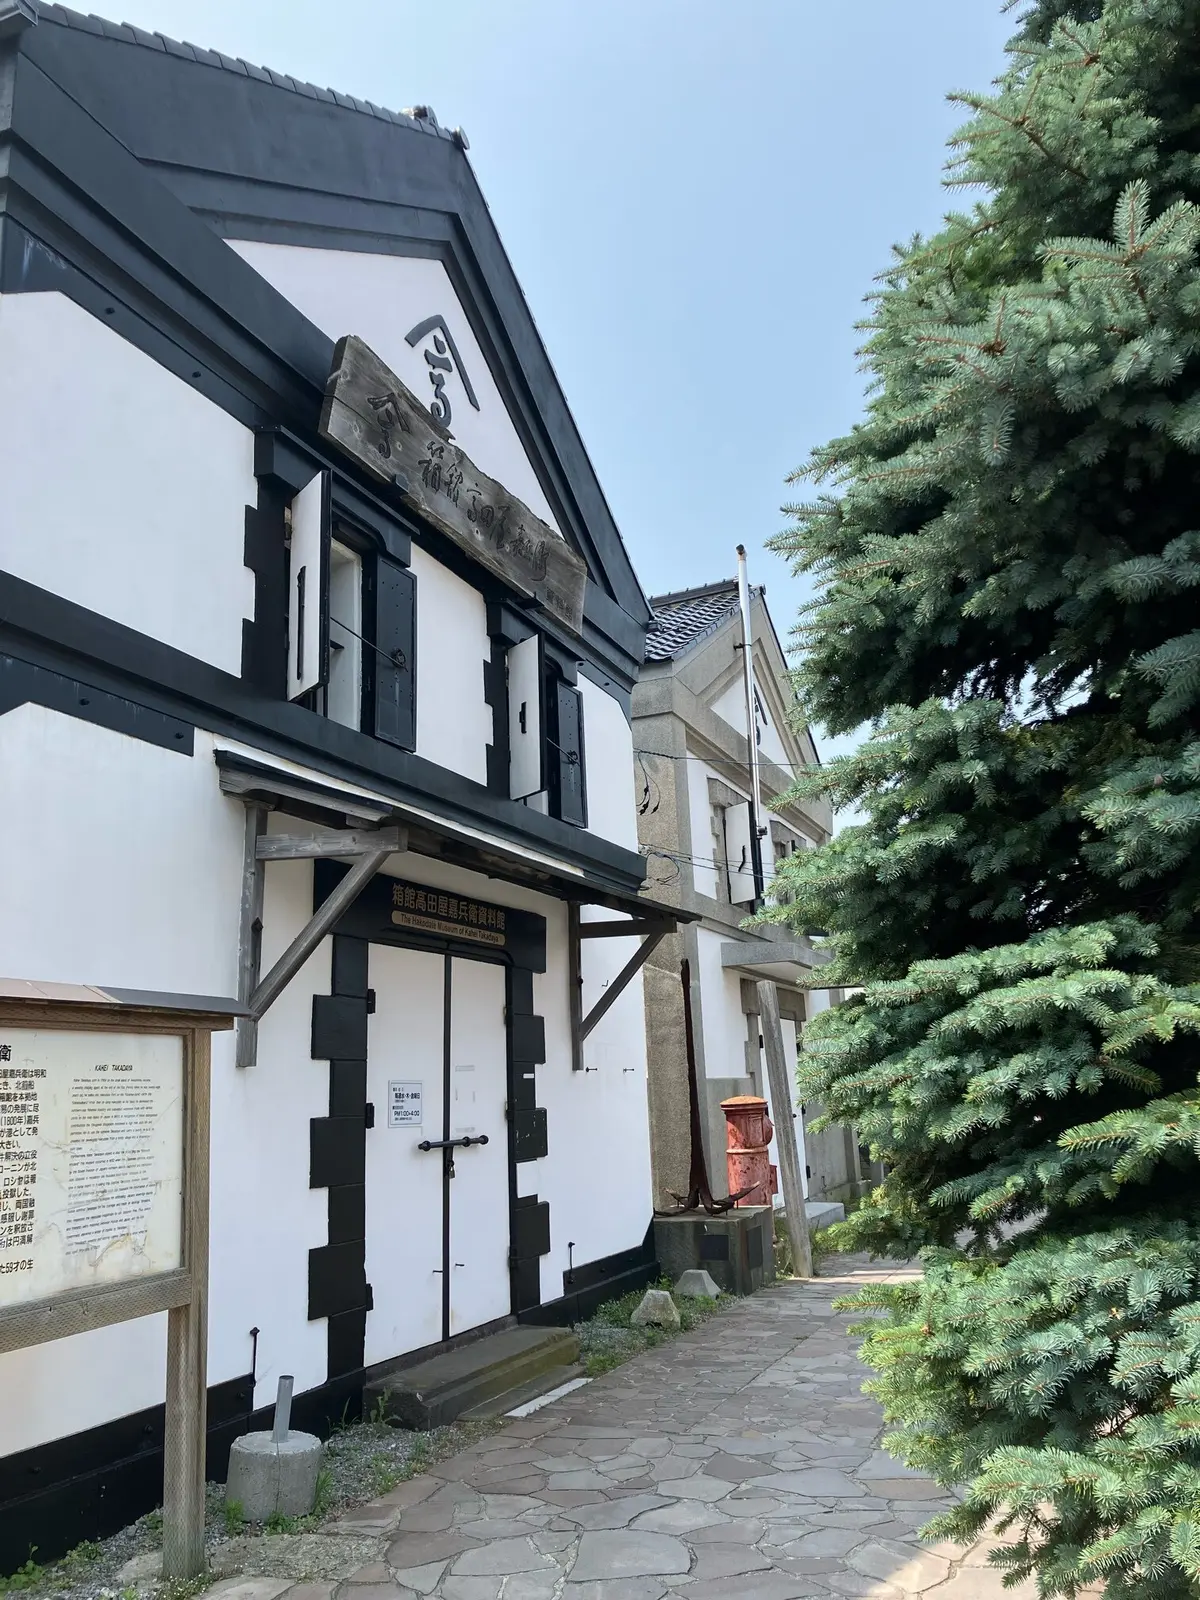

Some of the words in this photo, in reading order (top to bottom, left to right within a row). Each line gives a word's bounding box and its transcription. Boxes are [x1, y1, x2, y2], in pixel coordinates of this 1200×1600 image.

[401, 913, 411, 924] The
[413, 917, 437, 930] Hakodate
[437, 922, 459, 935] Museum
[459, 927, 466, 935] of
[465, 928, 478, 938] Kahei
[478, 931, 499, 944] Takadaya
[94, 1064, 109, 1072] KAHEI
[111, 1064, 133, 1072] TAKADAYA
